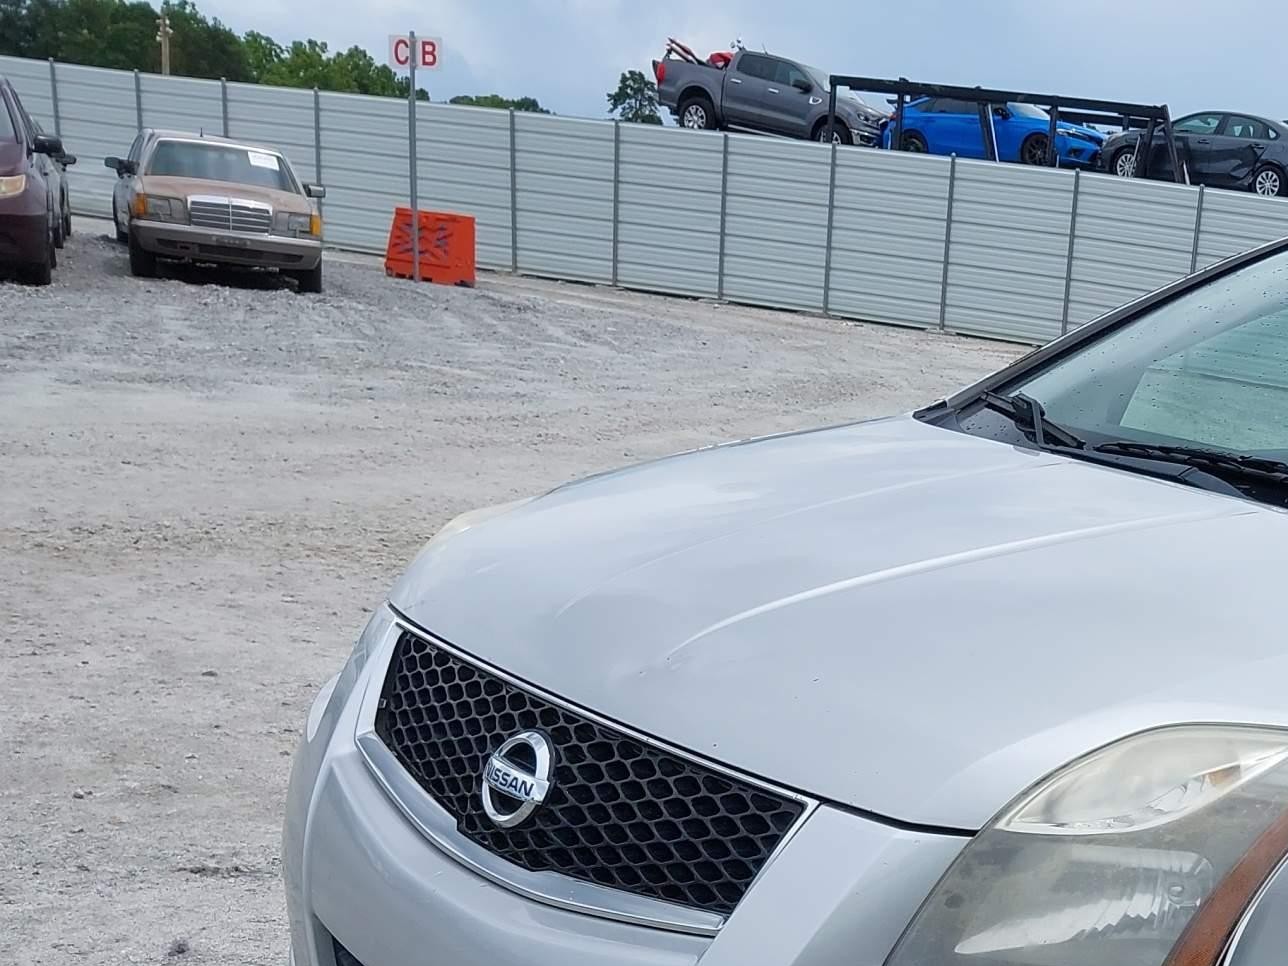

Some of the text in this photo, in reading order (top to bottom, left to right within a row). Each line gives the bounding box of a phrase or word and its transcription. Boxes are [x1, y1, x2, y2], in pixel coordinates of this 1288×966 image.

[394, 38, 437, 66] C B
[485, 761, 535, 797] NISSAN
